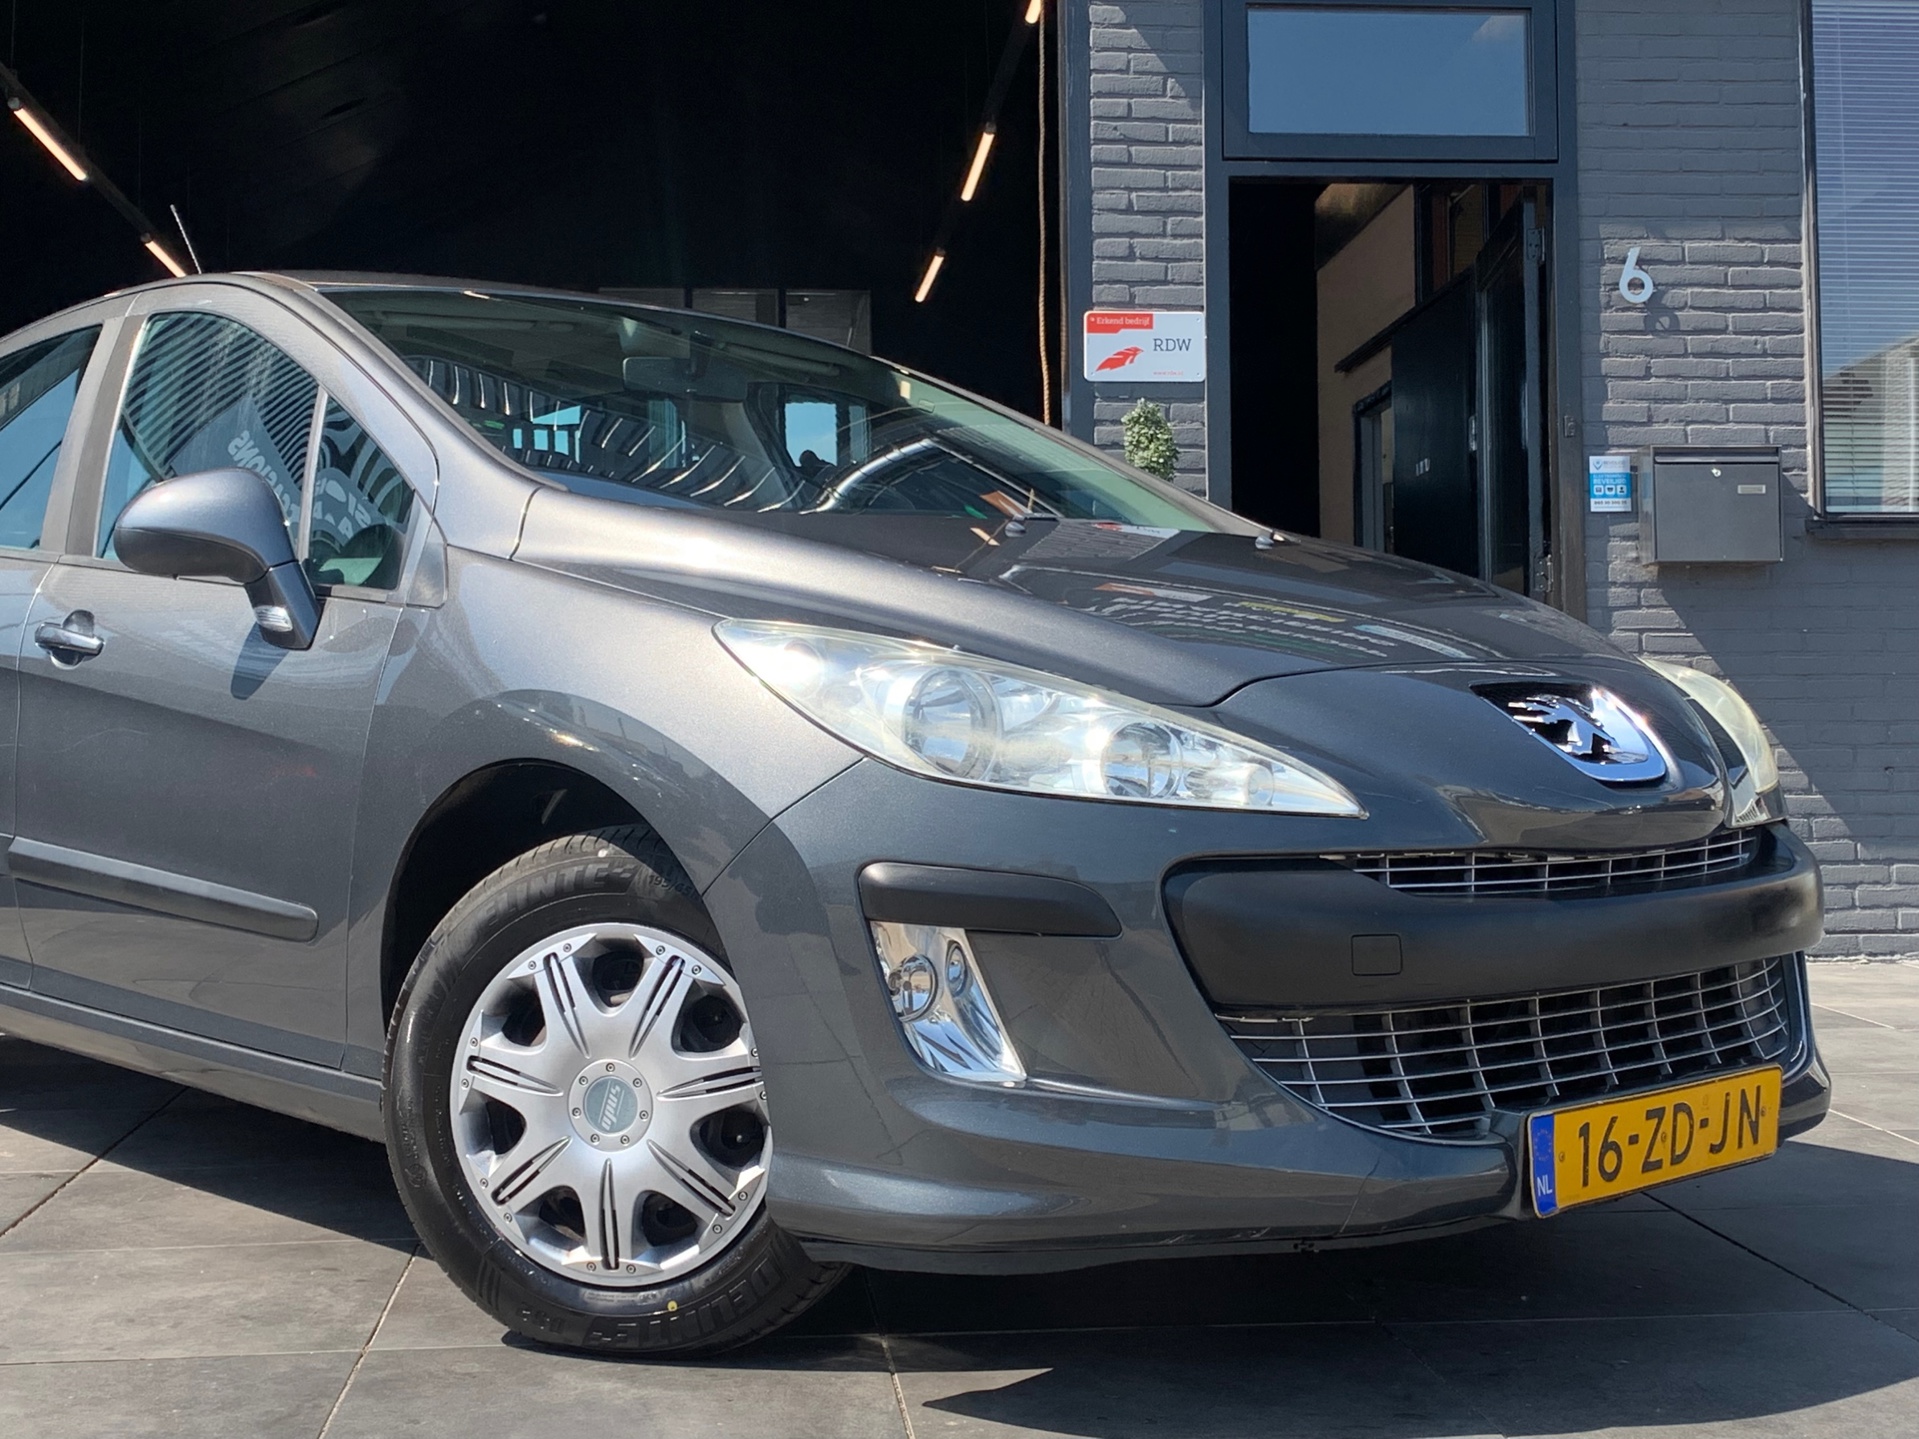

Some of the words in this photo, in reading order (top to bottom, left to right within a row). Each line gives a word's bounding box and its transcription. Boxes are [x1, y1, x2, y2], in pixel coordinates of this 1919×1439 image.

[1619, 246, 1654, 304] 6
[1096, 317, 1124, 326] Erkend
[1124, 317, 1151, 327] bedrijf
[1153, 338, 1192, 352] RDW
[1577, 1084, 1762, 1189] 16-ZD-JN
[1537, 1175, 1553, 1196] NL
